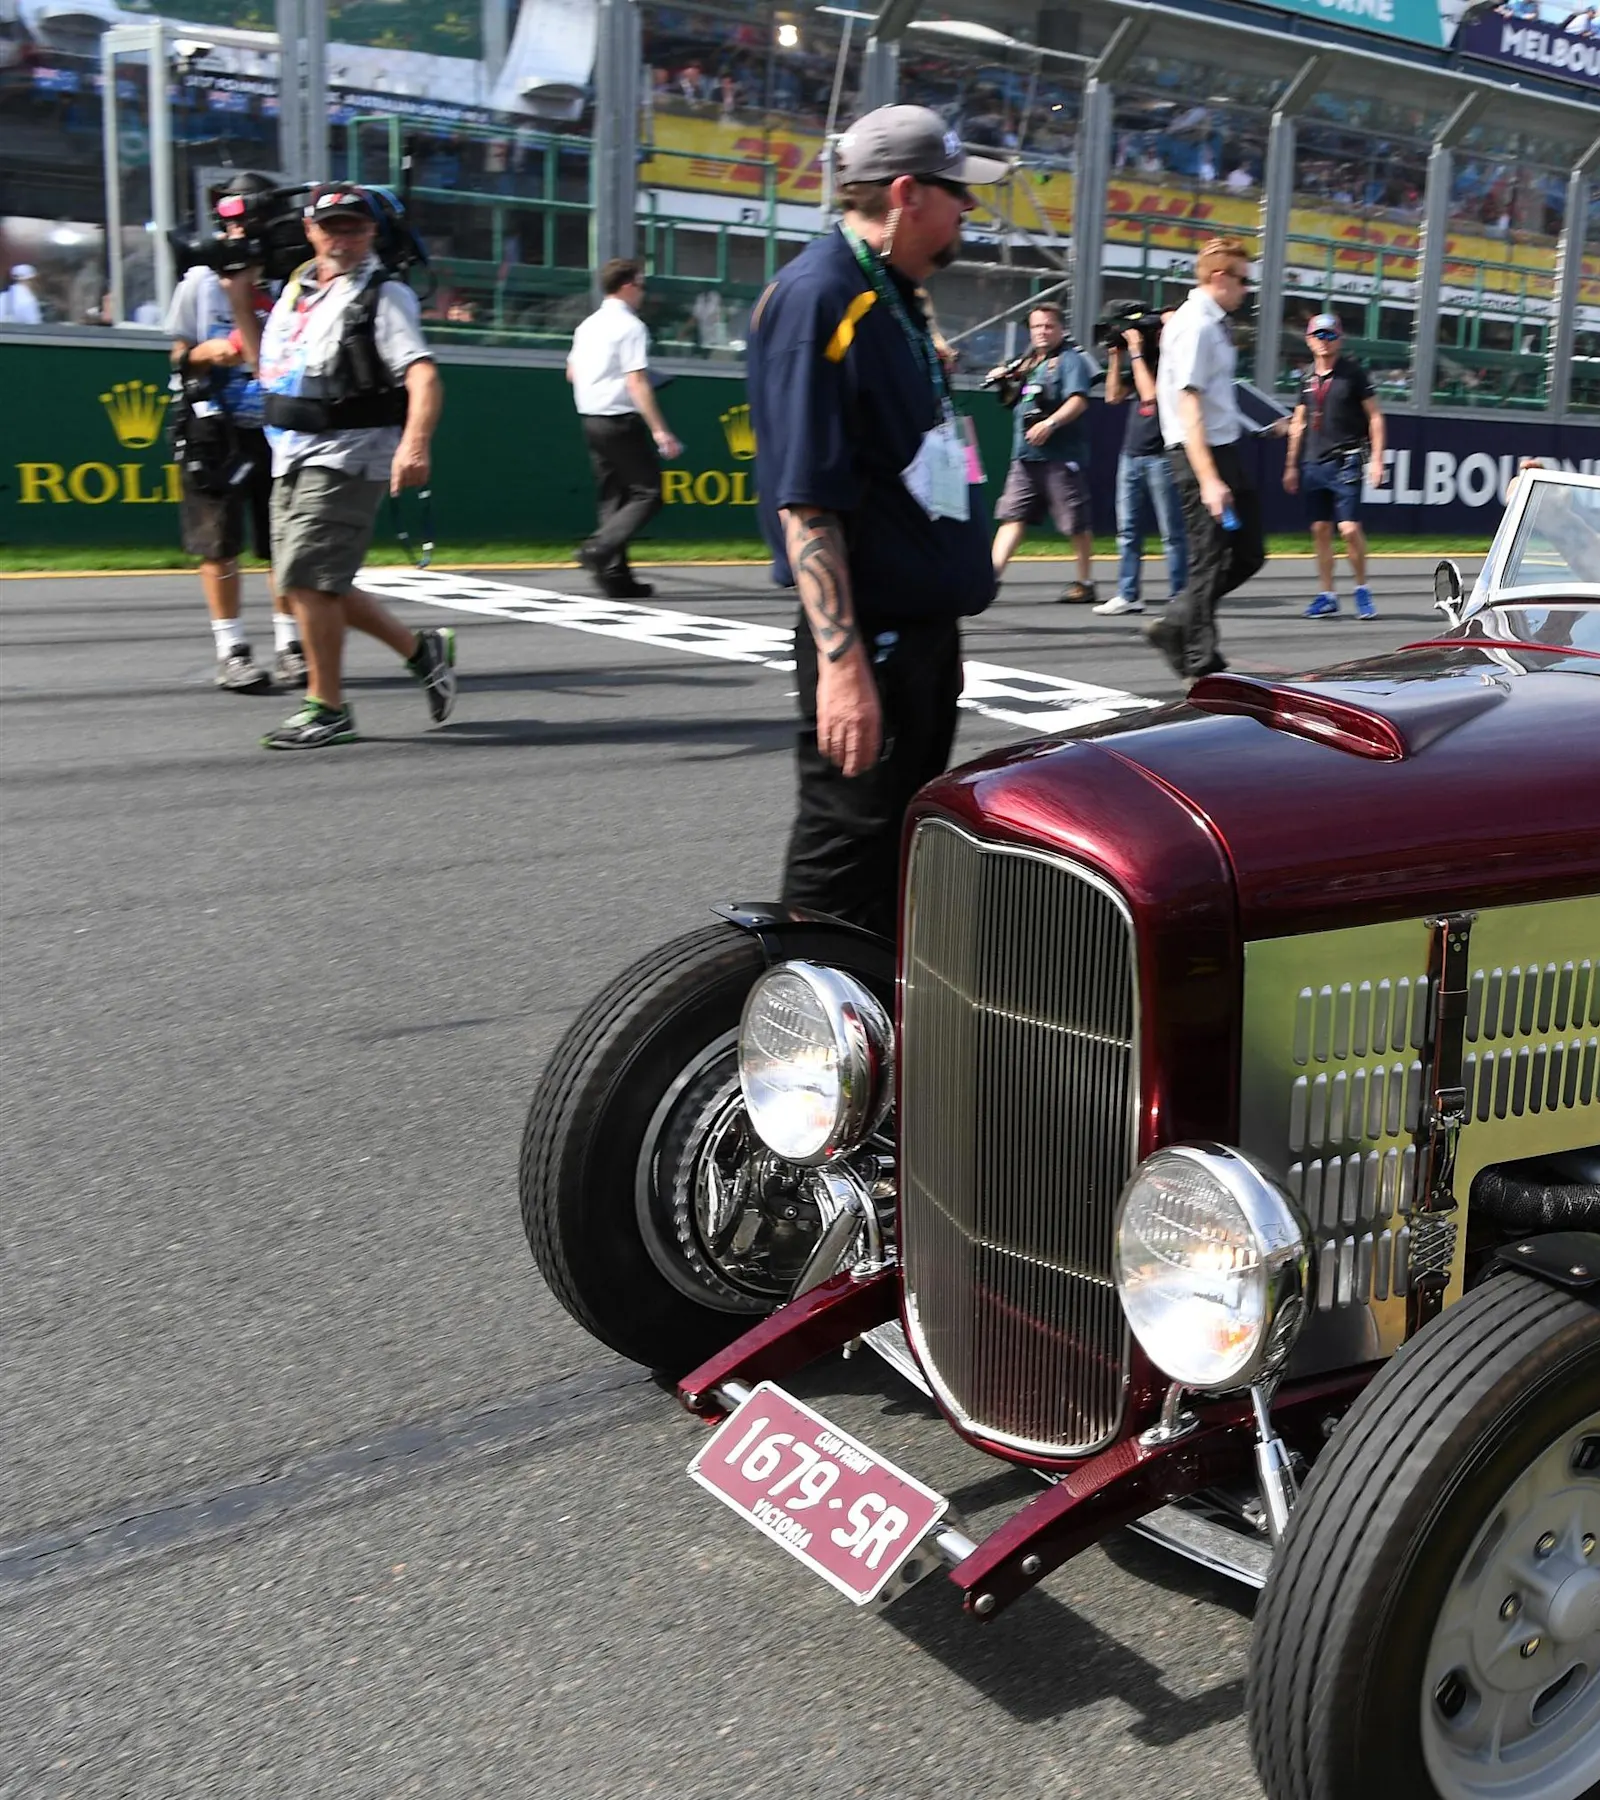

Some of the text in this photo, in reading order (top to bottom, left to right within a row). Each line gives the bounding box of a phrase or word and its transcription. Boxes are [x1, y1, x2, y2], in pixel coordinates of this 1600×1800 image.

[15, 462, 184, 504] ROL
[660, 470, 760, 505] ROL
[751, 1498, 814, 1550] VICTORIA
